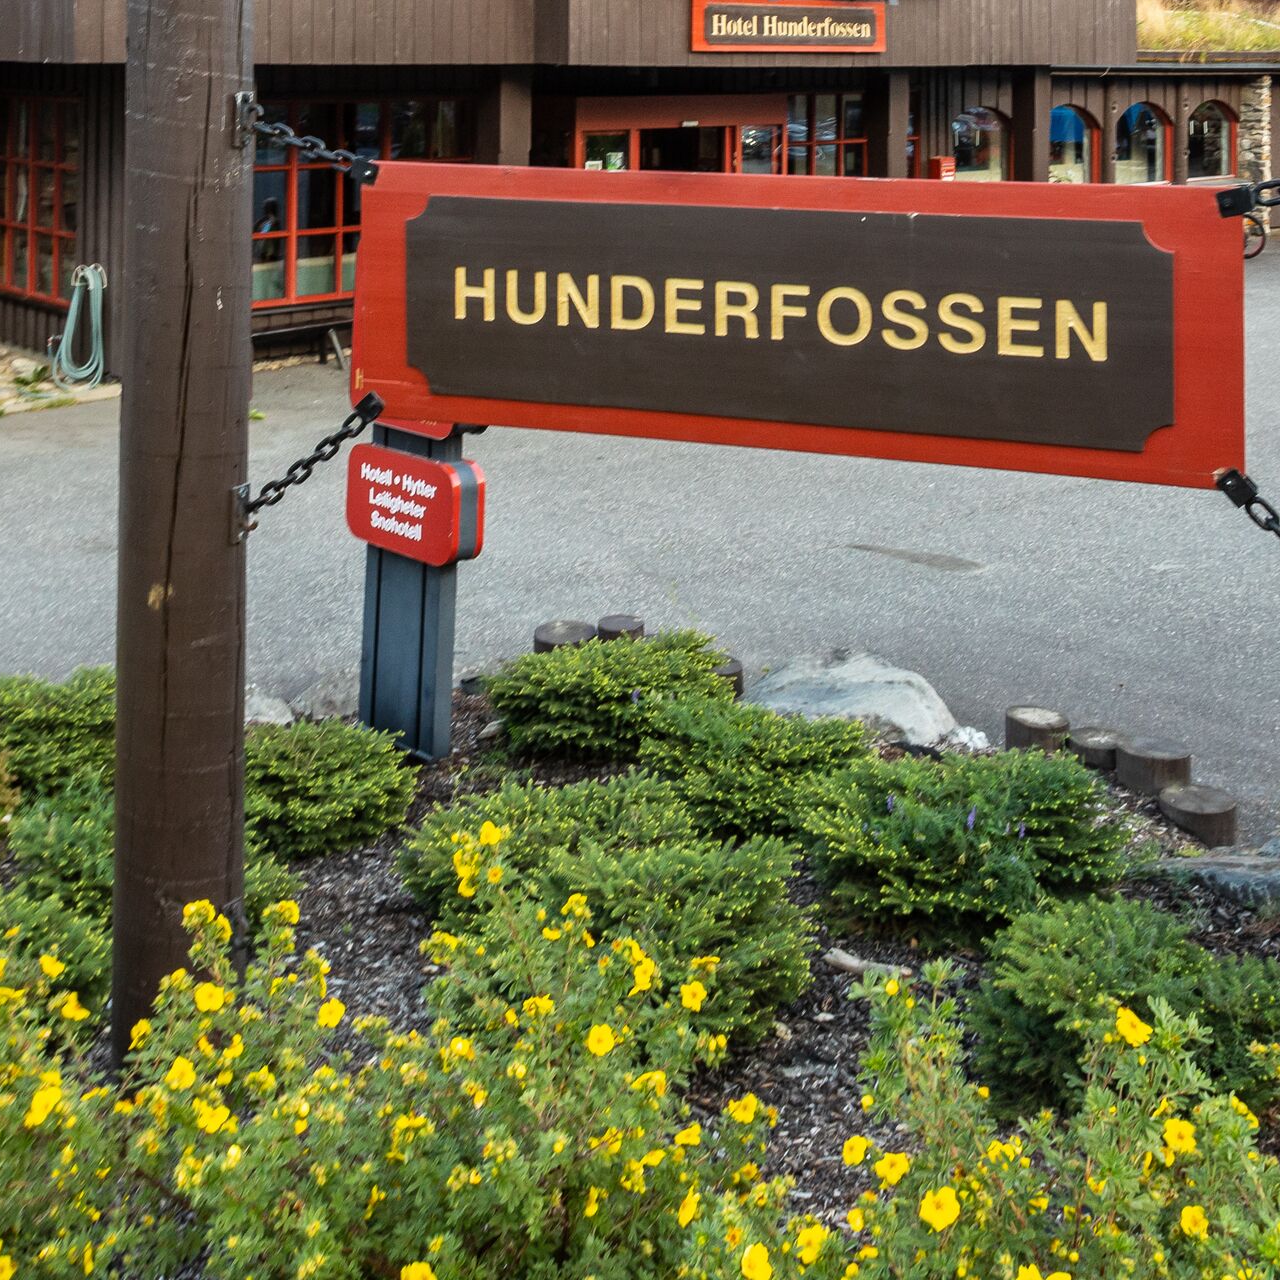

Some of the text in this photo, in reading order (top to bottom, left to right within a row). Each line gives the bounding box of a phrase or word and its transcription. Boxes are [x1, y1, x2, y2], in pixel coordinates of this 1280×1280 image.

[711, 14, 871, 39] Hotel Hunderfossen
[453, 265, 1108, 363] HUNDERFOSSEN
[360, 462, 437, 499] Hotell Hytter
[368, 487, 427, 519] Leiligheter
